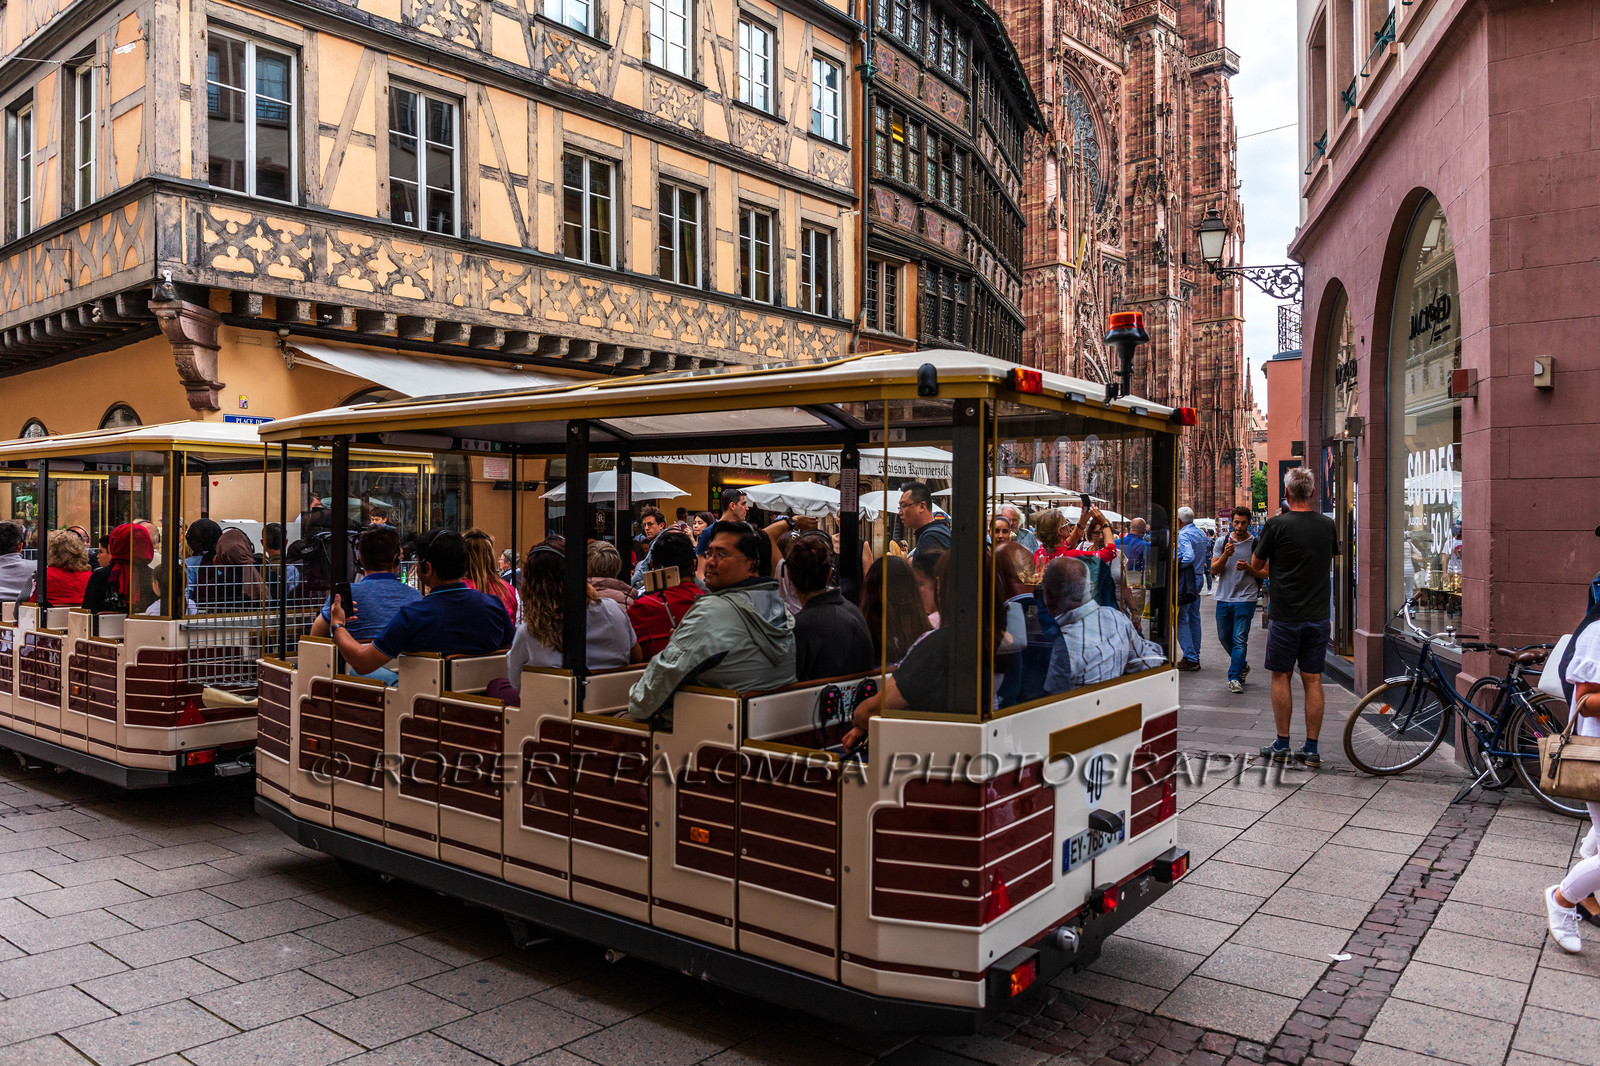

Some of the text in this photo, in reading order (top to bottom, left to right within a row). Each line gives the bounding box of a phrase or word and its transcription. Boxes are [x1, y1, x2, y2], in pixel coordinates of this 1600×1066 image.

[765, 452, 774, 467] &
[781, 452, 840, 471] RESTAUR
[1407, 444, 1454, 506] SOLDES
[1087, 755, 1104, 804] 40
